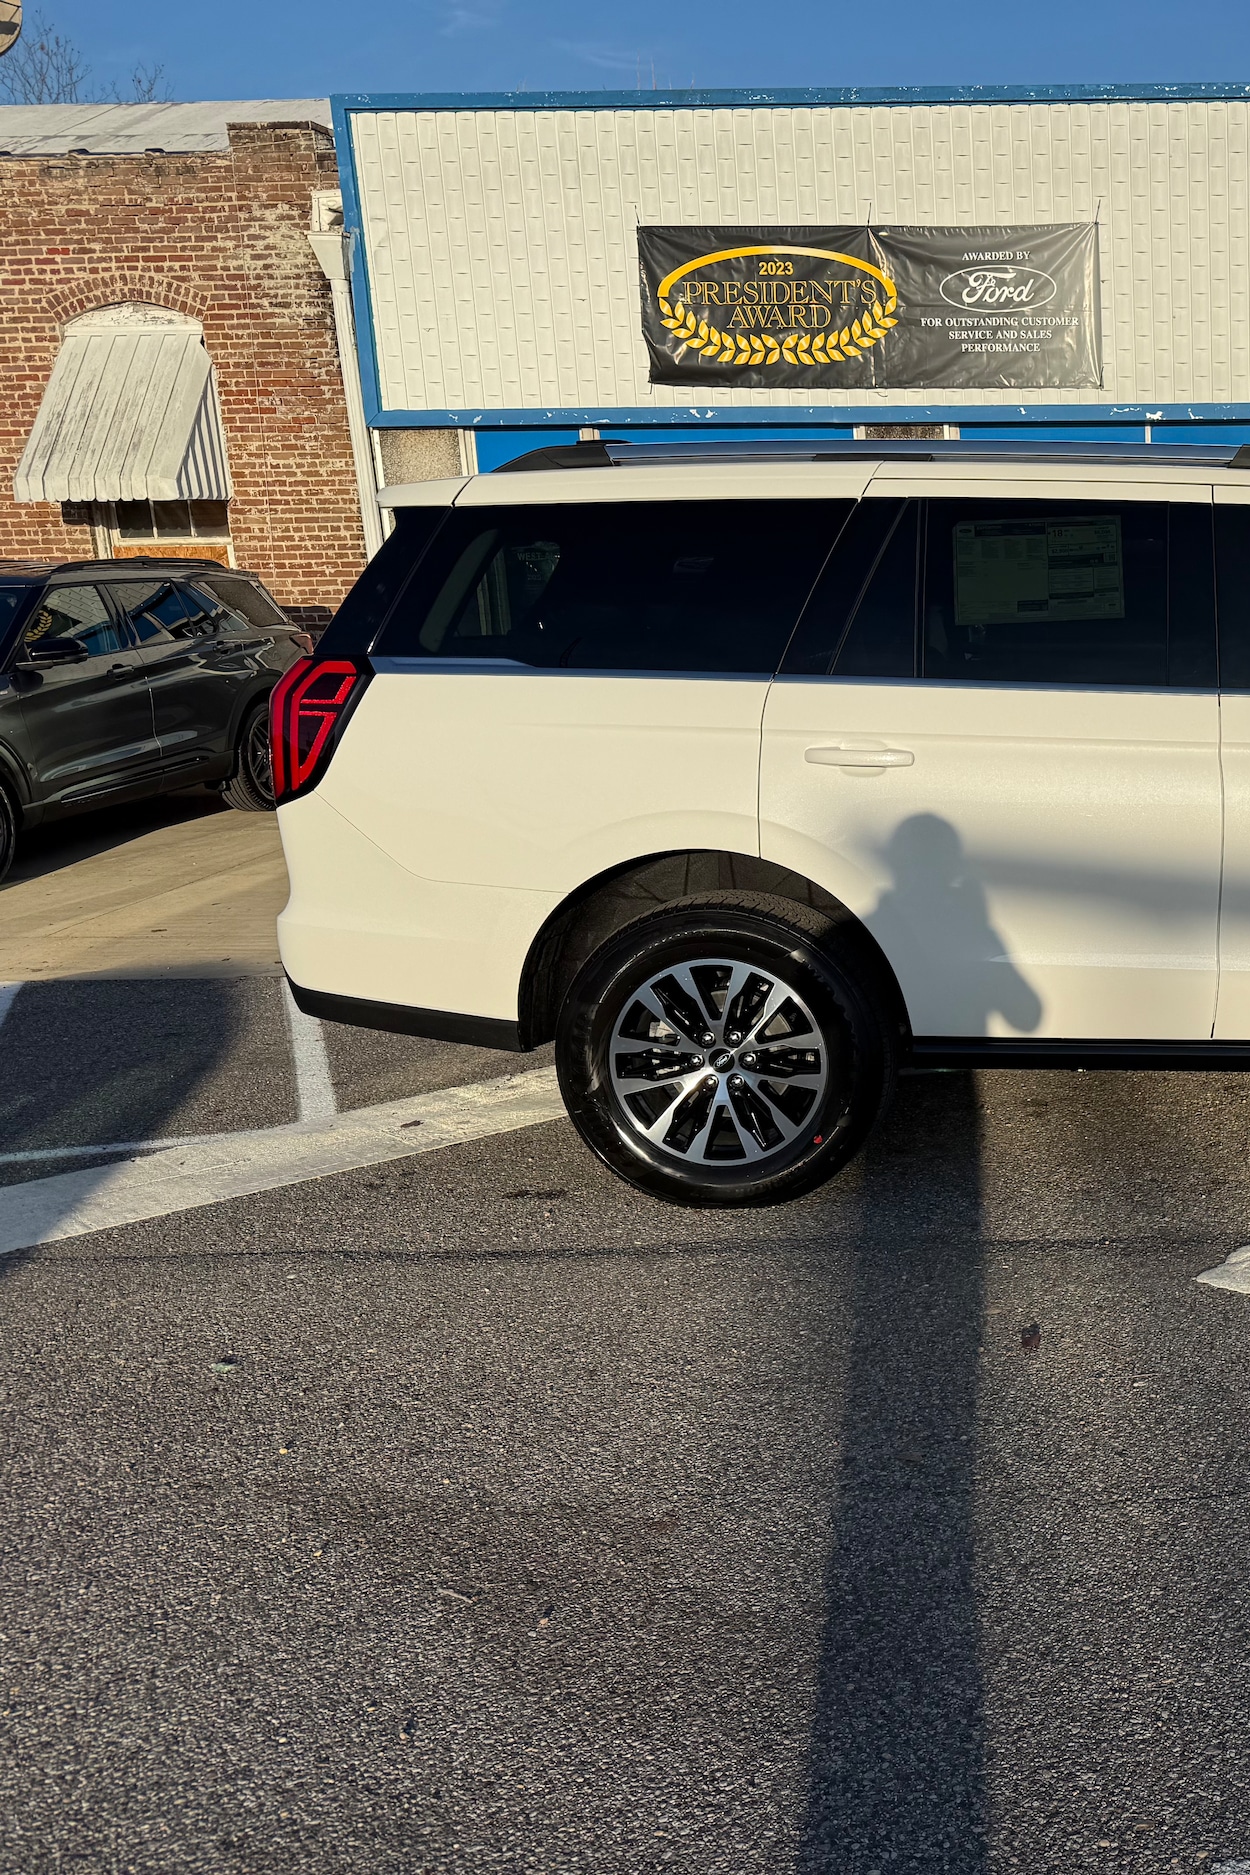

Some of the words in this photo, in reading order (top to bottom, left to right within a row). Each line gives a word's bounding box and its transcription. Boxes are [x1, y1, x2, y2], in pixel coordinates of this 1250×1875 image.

[962, 251, 1013, 261] AWARDED
[1016, 250, 1030, 260] BY
[759, 261, 794, 275] 2023
[682, 279, 877, 305] PRESIDENT'S
[962, 271, 1034, 304] Ford
[726, 304, 831, 329] AWARD
[921, 318, 943, 327] FOR
[945, 317, 1019, 327] OUTSTANDING
[1021, 316, 1079, 326] CUSTOMER
[948, 330, 993, 340] SERVICE
[996, 330, 1018, 340] AND
[1020, 330, 1052, 339] SALES
[961, 343, 1040, 353] PERFORMANCE
